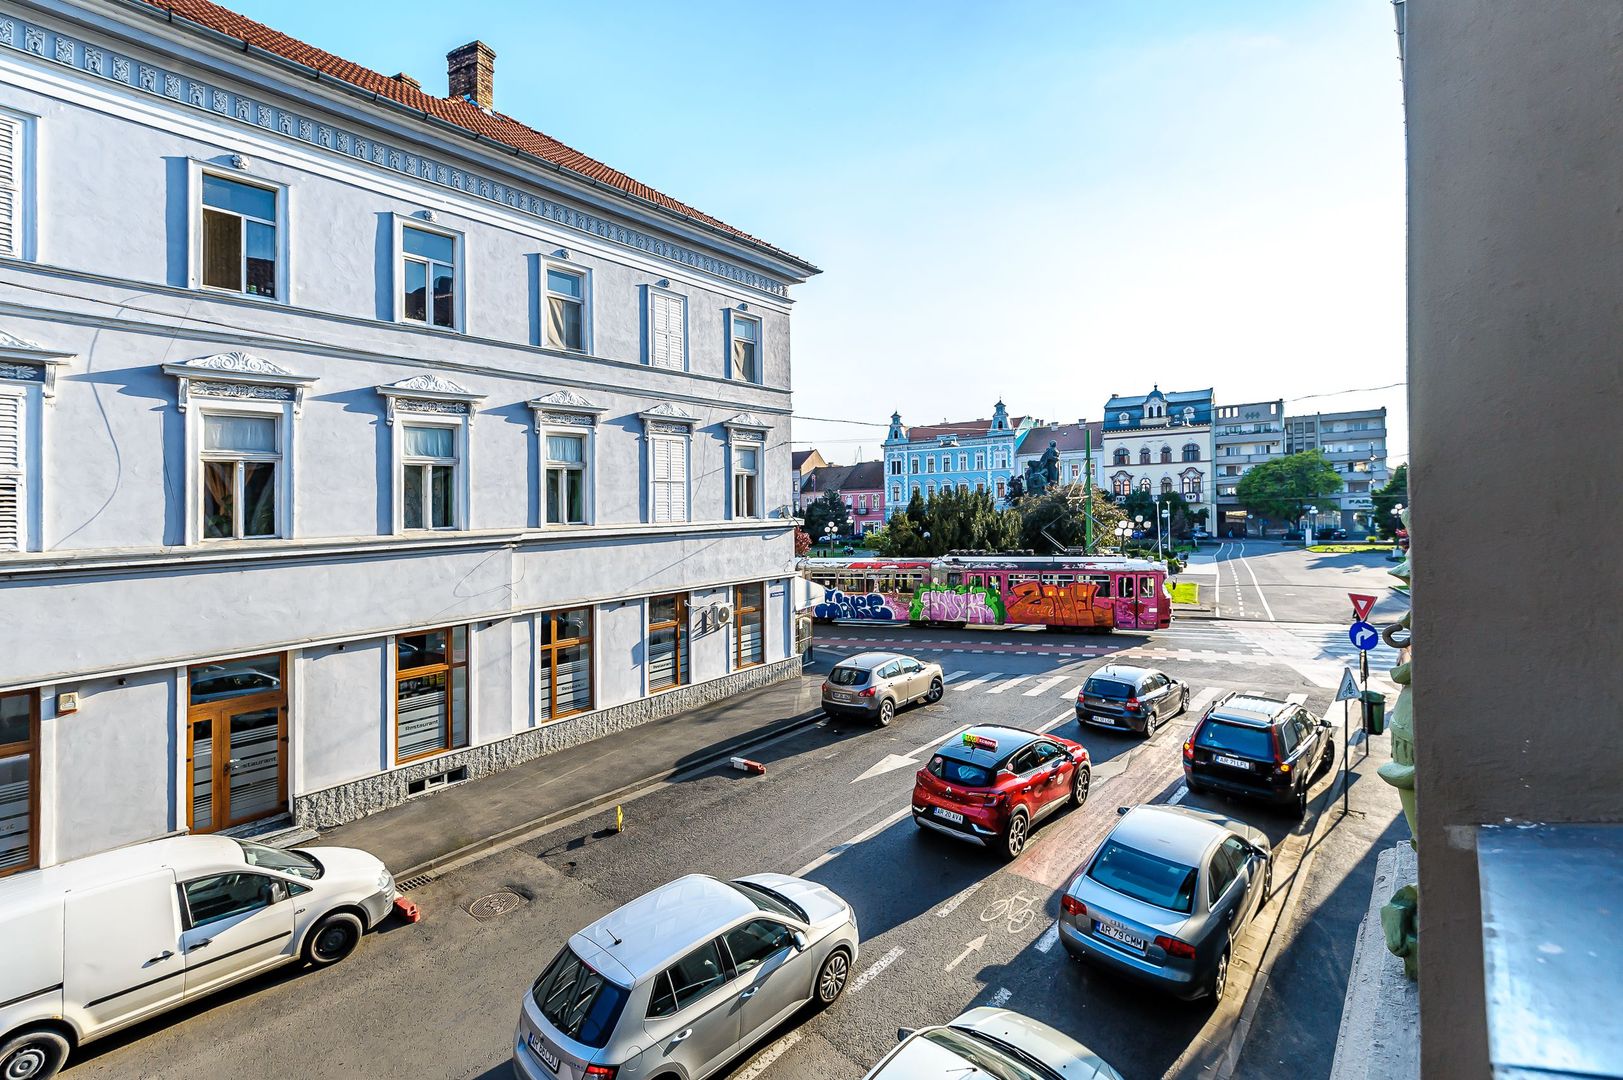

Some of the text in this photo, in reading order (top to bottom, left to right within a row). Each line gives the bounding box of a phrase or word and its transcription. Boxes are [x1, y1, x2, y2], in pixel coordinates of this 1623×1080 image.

[405, 719, 439, 731] Restaurant
[952, 813, 962, 821] AVA
[1101, 922, 1143, 948] AR 79 CMM
